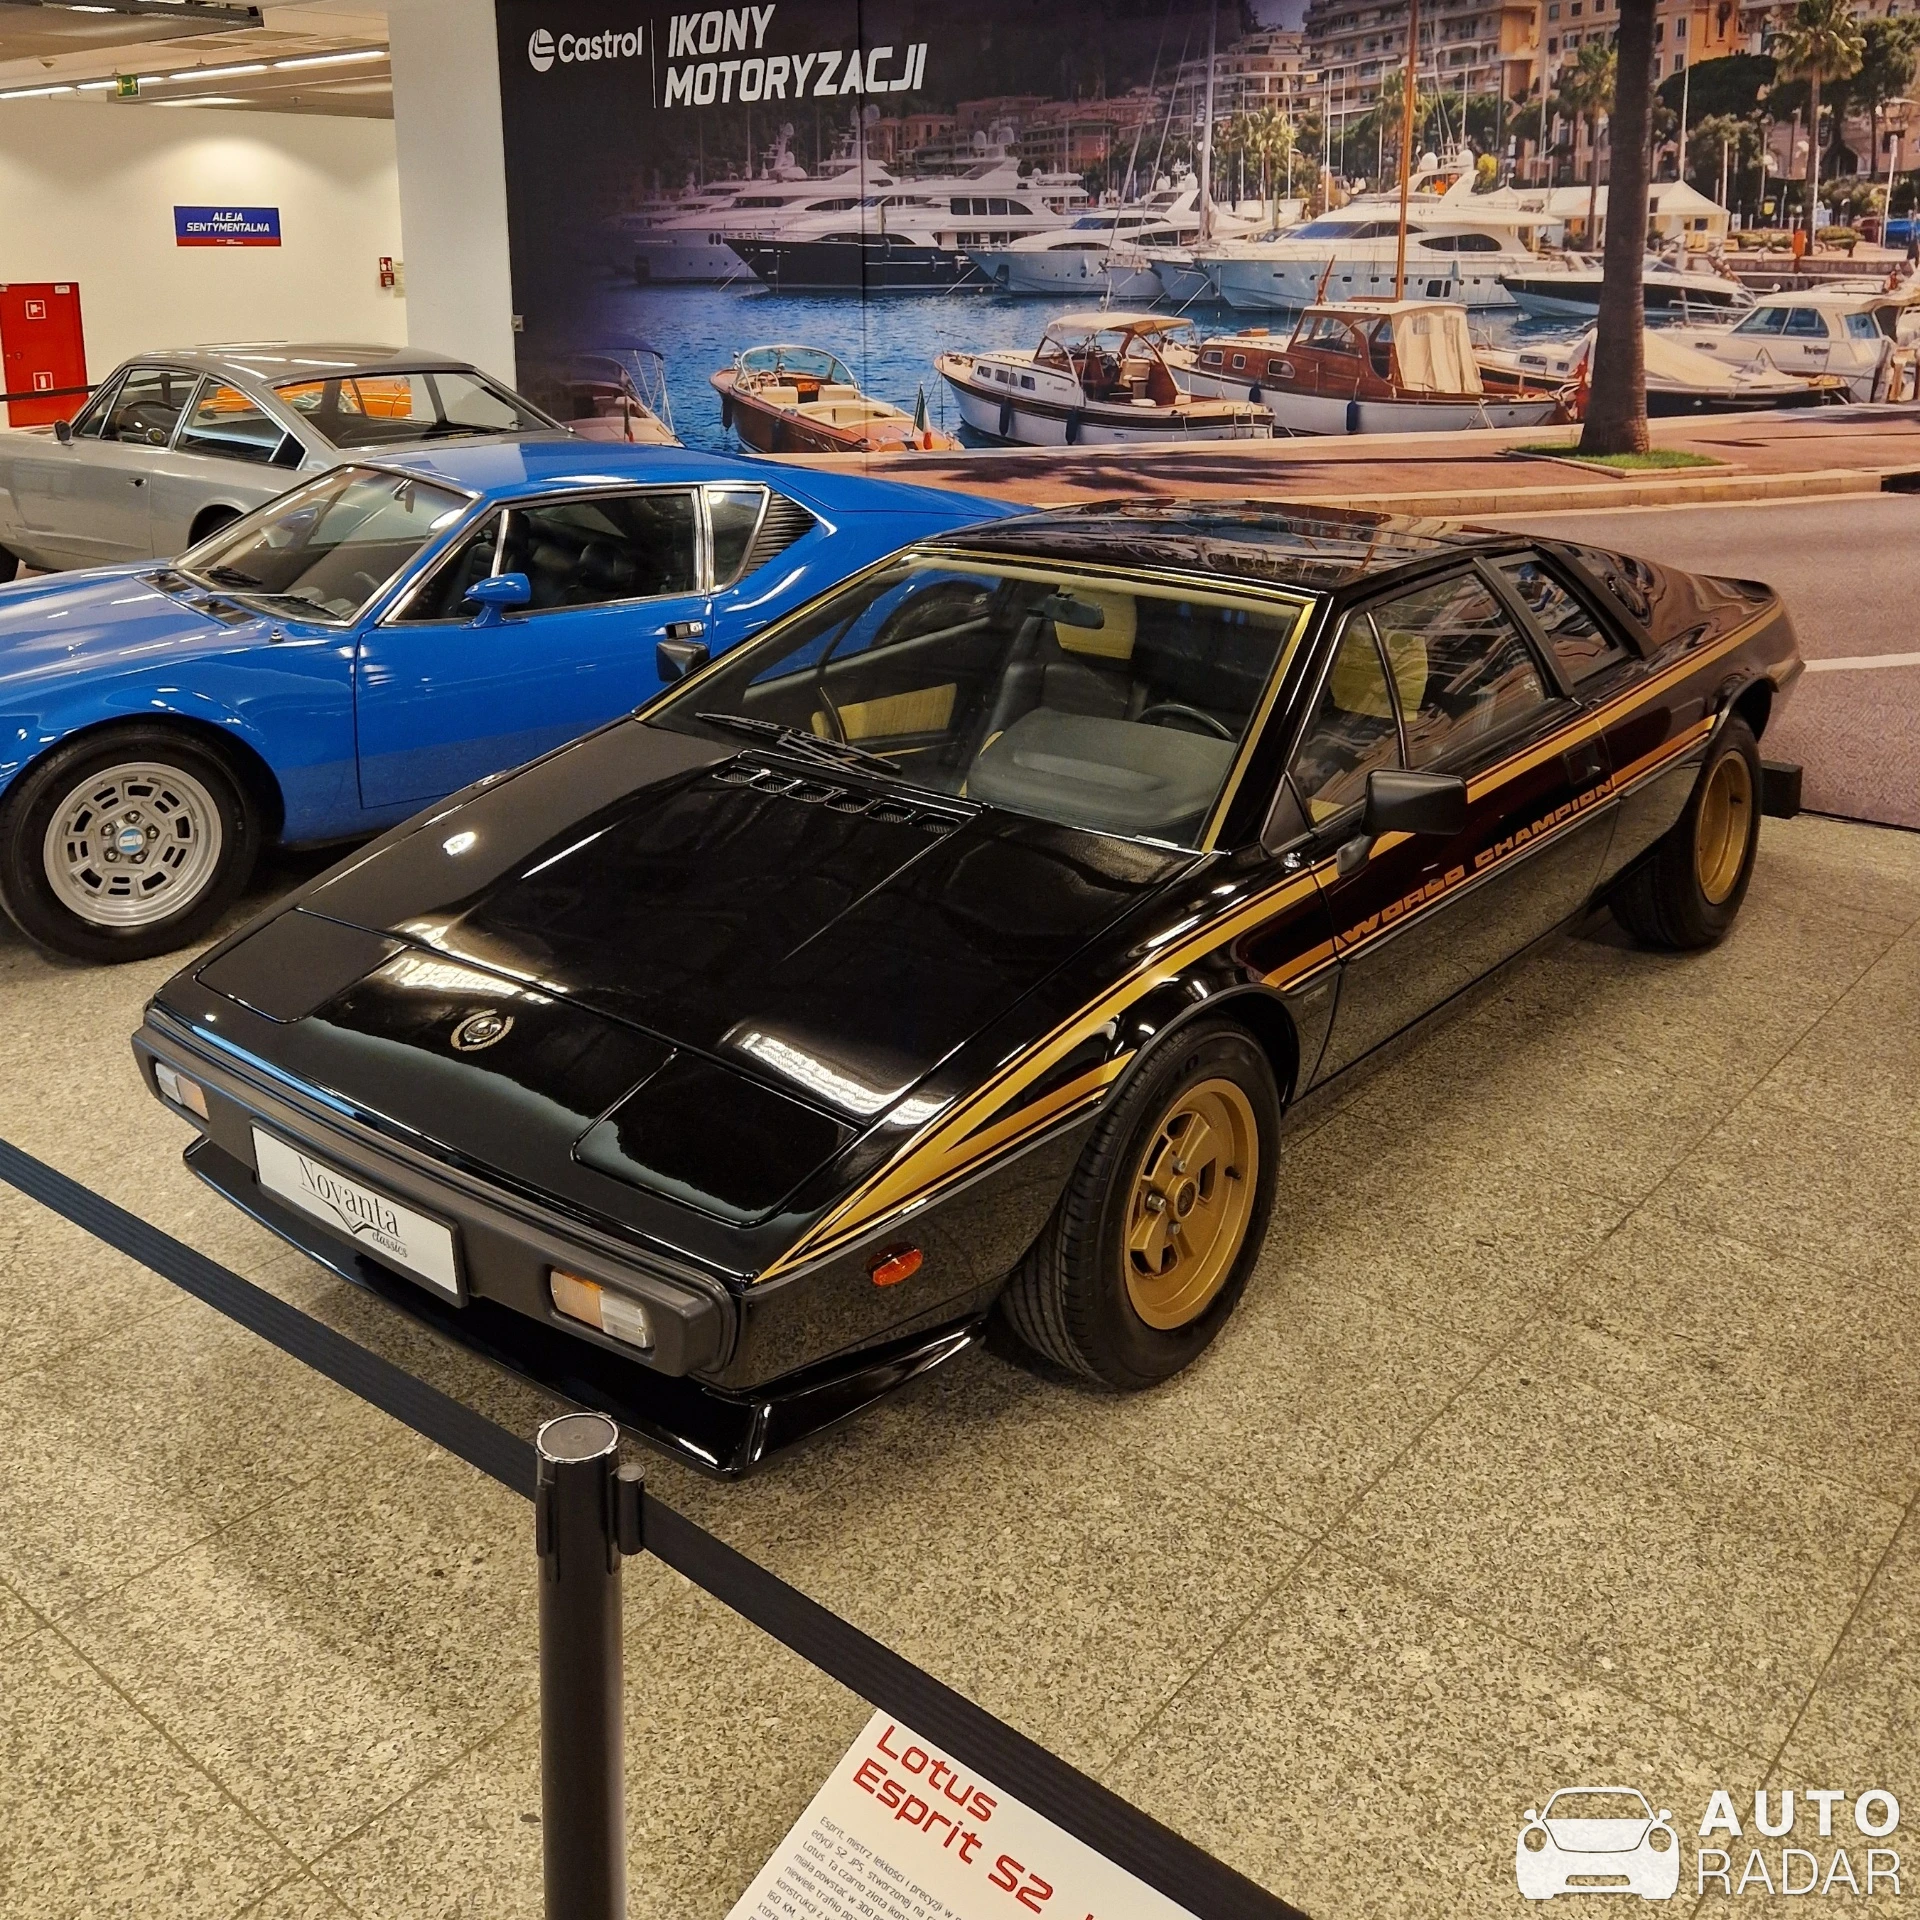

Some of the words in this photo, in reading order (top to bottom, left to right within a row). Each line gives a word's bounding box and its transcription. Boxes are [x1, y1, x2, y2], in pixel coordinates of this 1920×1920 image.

[558, 25, 643, 63] Castrol
[667, 4, 776, 58] IKONY
[664, 43, 928, 108] MOTORYZACJI
[186, 222, 270, 232] SENTYMENTALNA
[212, 212, 244, 222] ALEJA
[1341, 865, 1466, 943] WORLD
[1474, 779, 1612, 869] CHAMPION
[297, 1155, 400, 1238] Novanta
[371, 1231, 408, 1258] classics
[876, 1725, 998, 1822] Lotus
[853, 1758, 983, 1865] Esprit
[987, 1854, 1054, 1915] S2
[784, 1866, 816, 1892] niewiele
[816, 1889, 842, 1913] trafiło
[794, 1853, 816, 1873] miała
[814, 1870, 849, 1898] powstać
[847, 1894, 857, 1904] w
[855, 1900, 874, 1917] 300
[811, 1829, 835, 1849] edycji
[835, 1846, 848, 1859] S2
[866, 1871, 914, 1909] stworzonej
[912, 1906, 925, 1918] na
[820, 1816, 845, 1840] Esprit,
[846, 1837, 873, 1860] mistrz
[873, 1856, 905, 1883] lekkości
[909, 1884, 944, 1912] precyzji
[944, 1909, 954, 1919] w
[828, 1860, 838, 1871] Ta
[838, 1869, 866, 1892] czarno
[865, 1889, 888, 1909] złota
[767, 1889, 782, 1904] 160
[775, 1877, 818, 1914] konstrukcji
